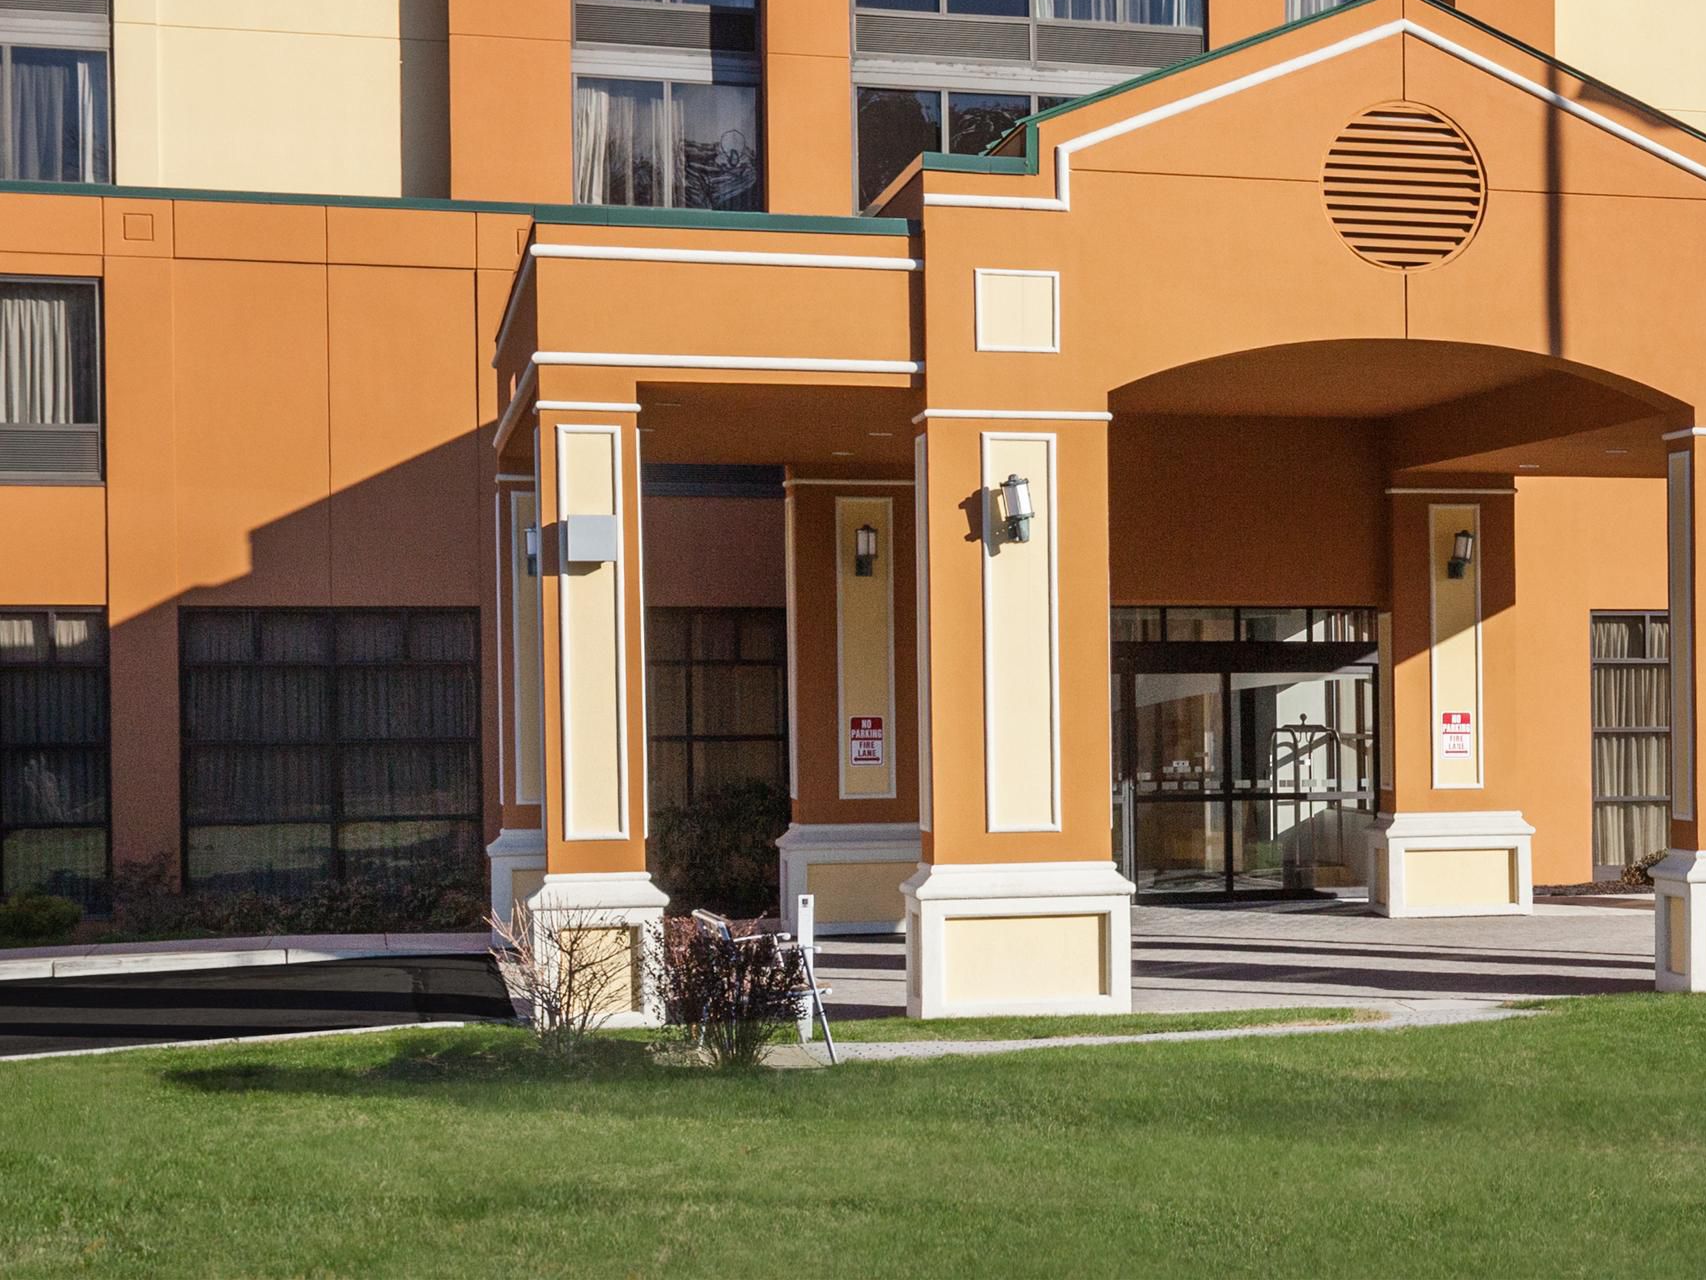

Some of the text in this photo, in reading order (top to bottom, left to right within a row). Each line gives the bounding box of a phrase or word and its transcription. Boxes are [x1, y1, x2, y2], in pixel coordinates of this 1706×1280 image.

[861, 719, 872, 729] NO
[851, 729, 882, 738] PARKING
[859, 741, 875, 749] FIRE
[857, 749, 877, 757] LANE
